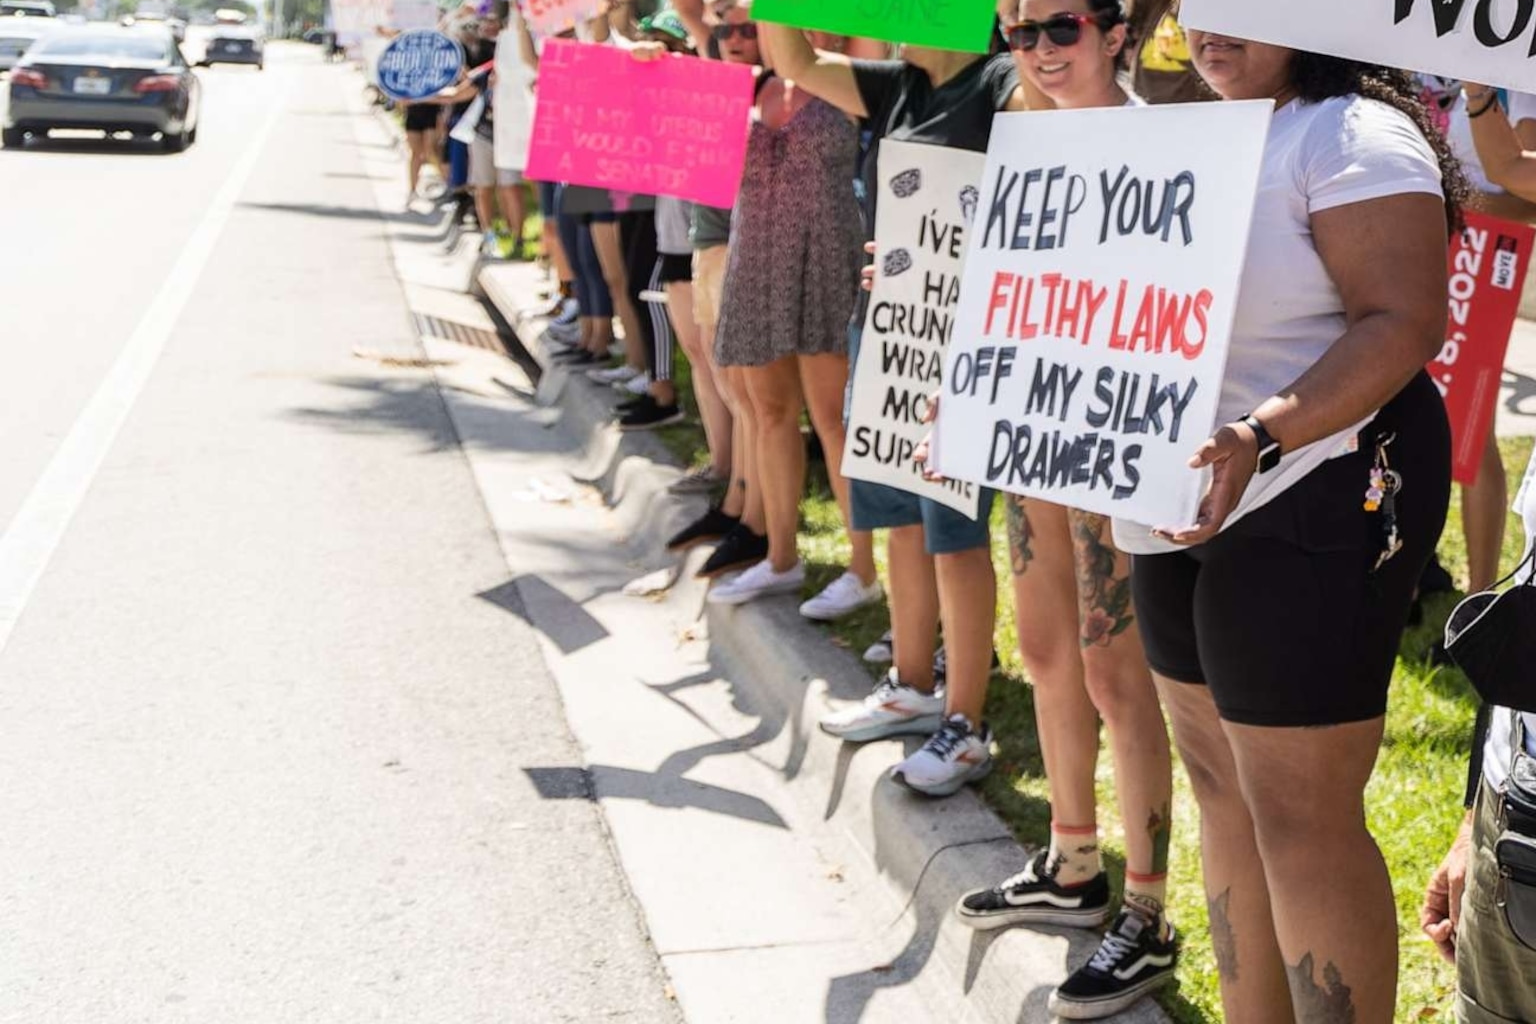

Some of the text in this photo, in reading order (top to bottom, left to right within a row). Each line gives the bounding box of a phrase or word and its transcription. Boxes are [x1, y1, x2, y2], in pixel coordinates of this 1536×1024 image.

[980, 163, 1196, 252] KEEP YOUR
[982, 271, 1214, 361] FILTHY LAWS
[1447, 224, 1490, 327] 2022
[949, 345, 1199, 444] OFF MY SILKY
[985, 418, 1143, 501] DRAWERS
